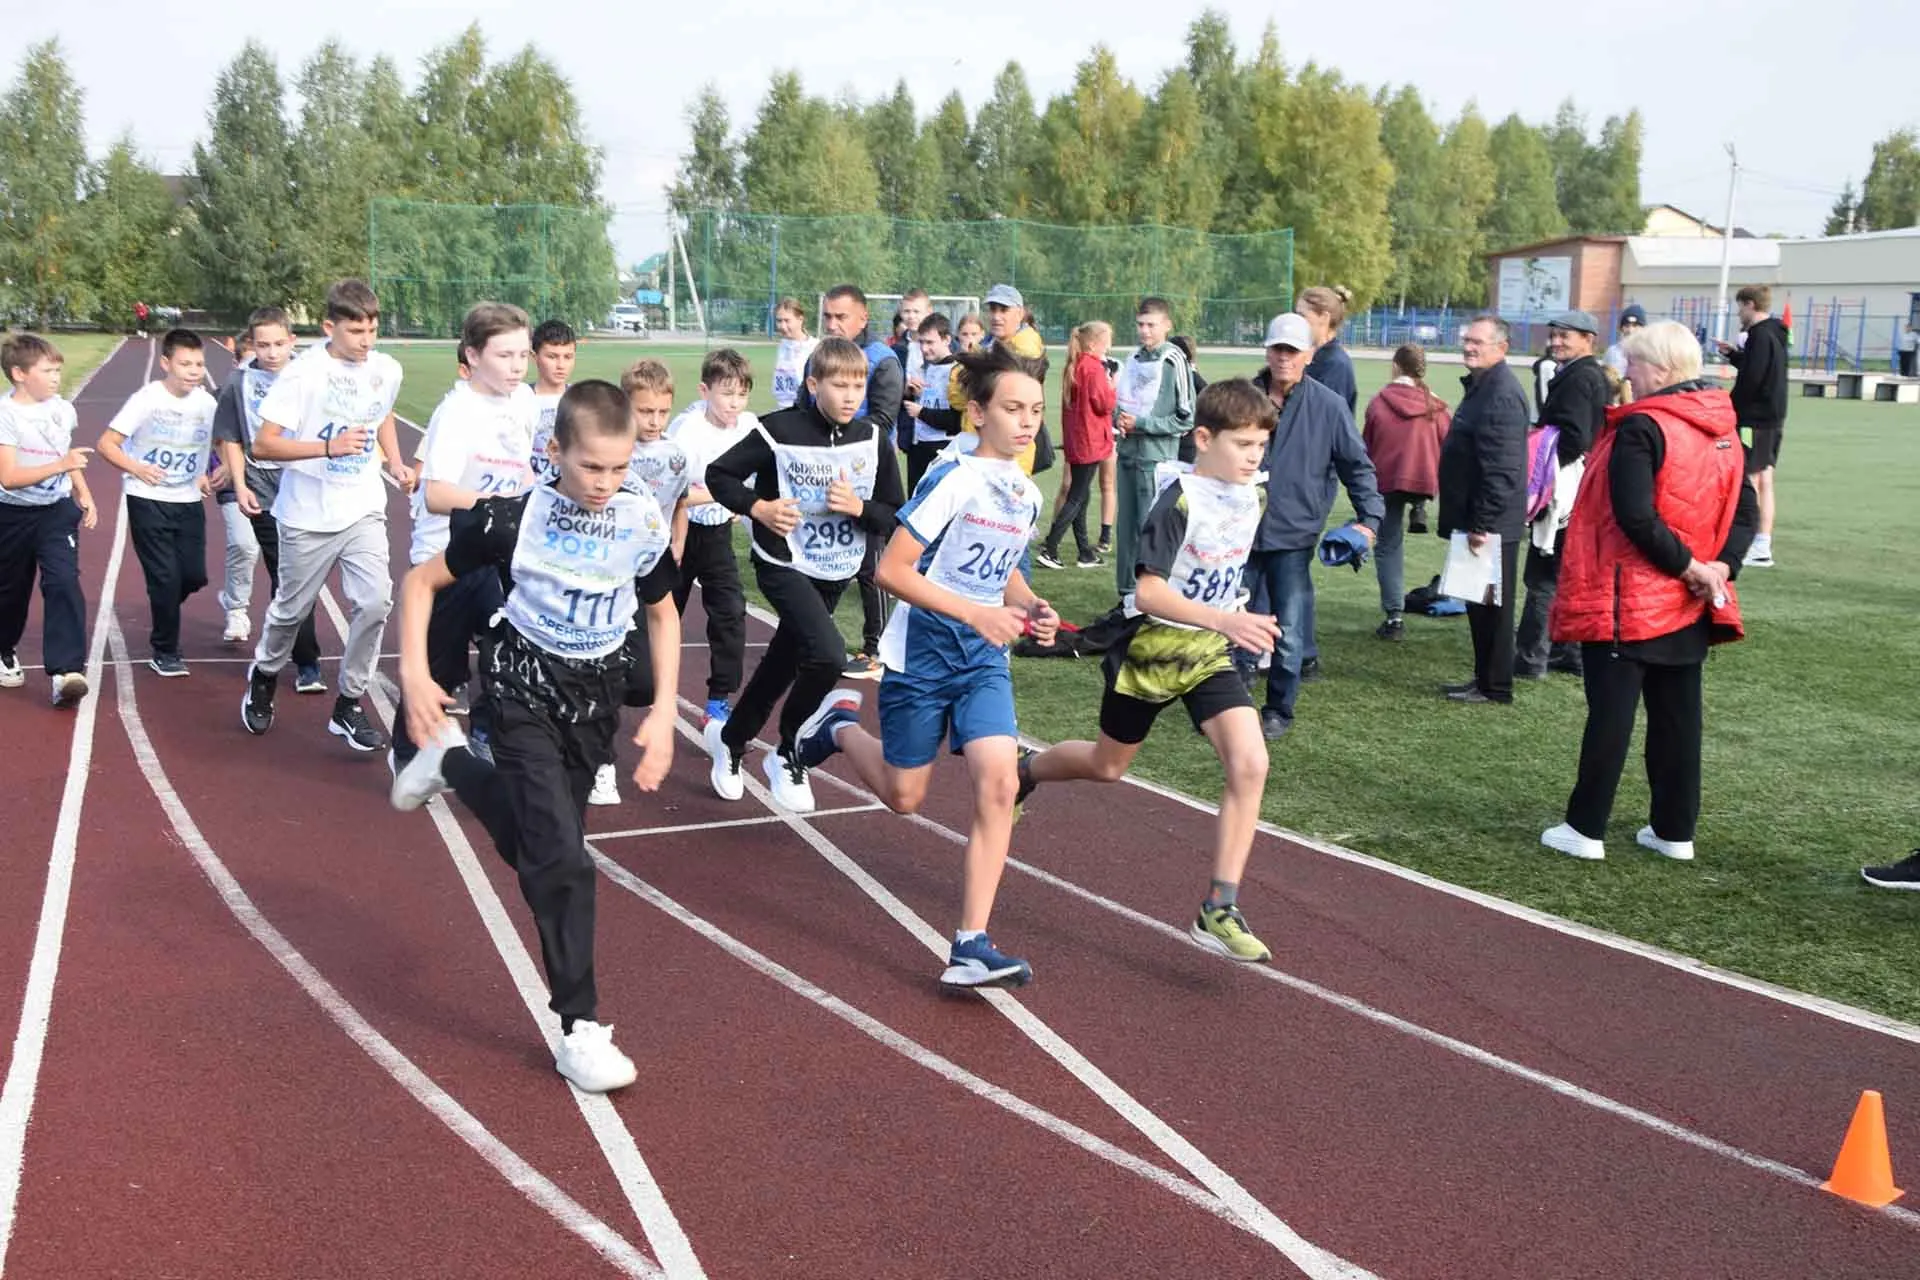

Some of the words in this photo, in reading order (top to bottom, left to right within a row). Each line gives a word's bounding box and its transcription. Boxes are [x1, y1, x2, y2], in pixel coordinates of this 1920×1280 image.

[143, 447, 198, 473] 4978
[786, 462, 833, 475] ЛЫЖНЯ
[546, 511, 617, 541] РОССИИ
[803, 519, 855, 549] 298
[543, 529, 610, 561] 2021
